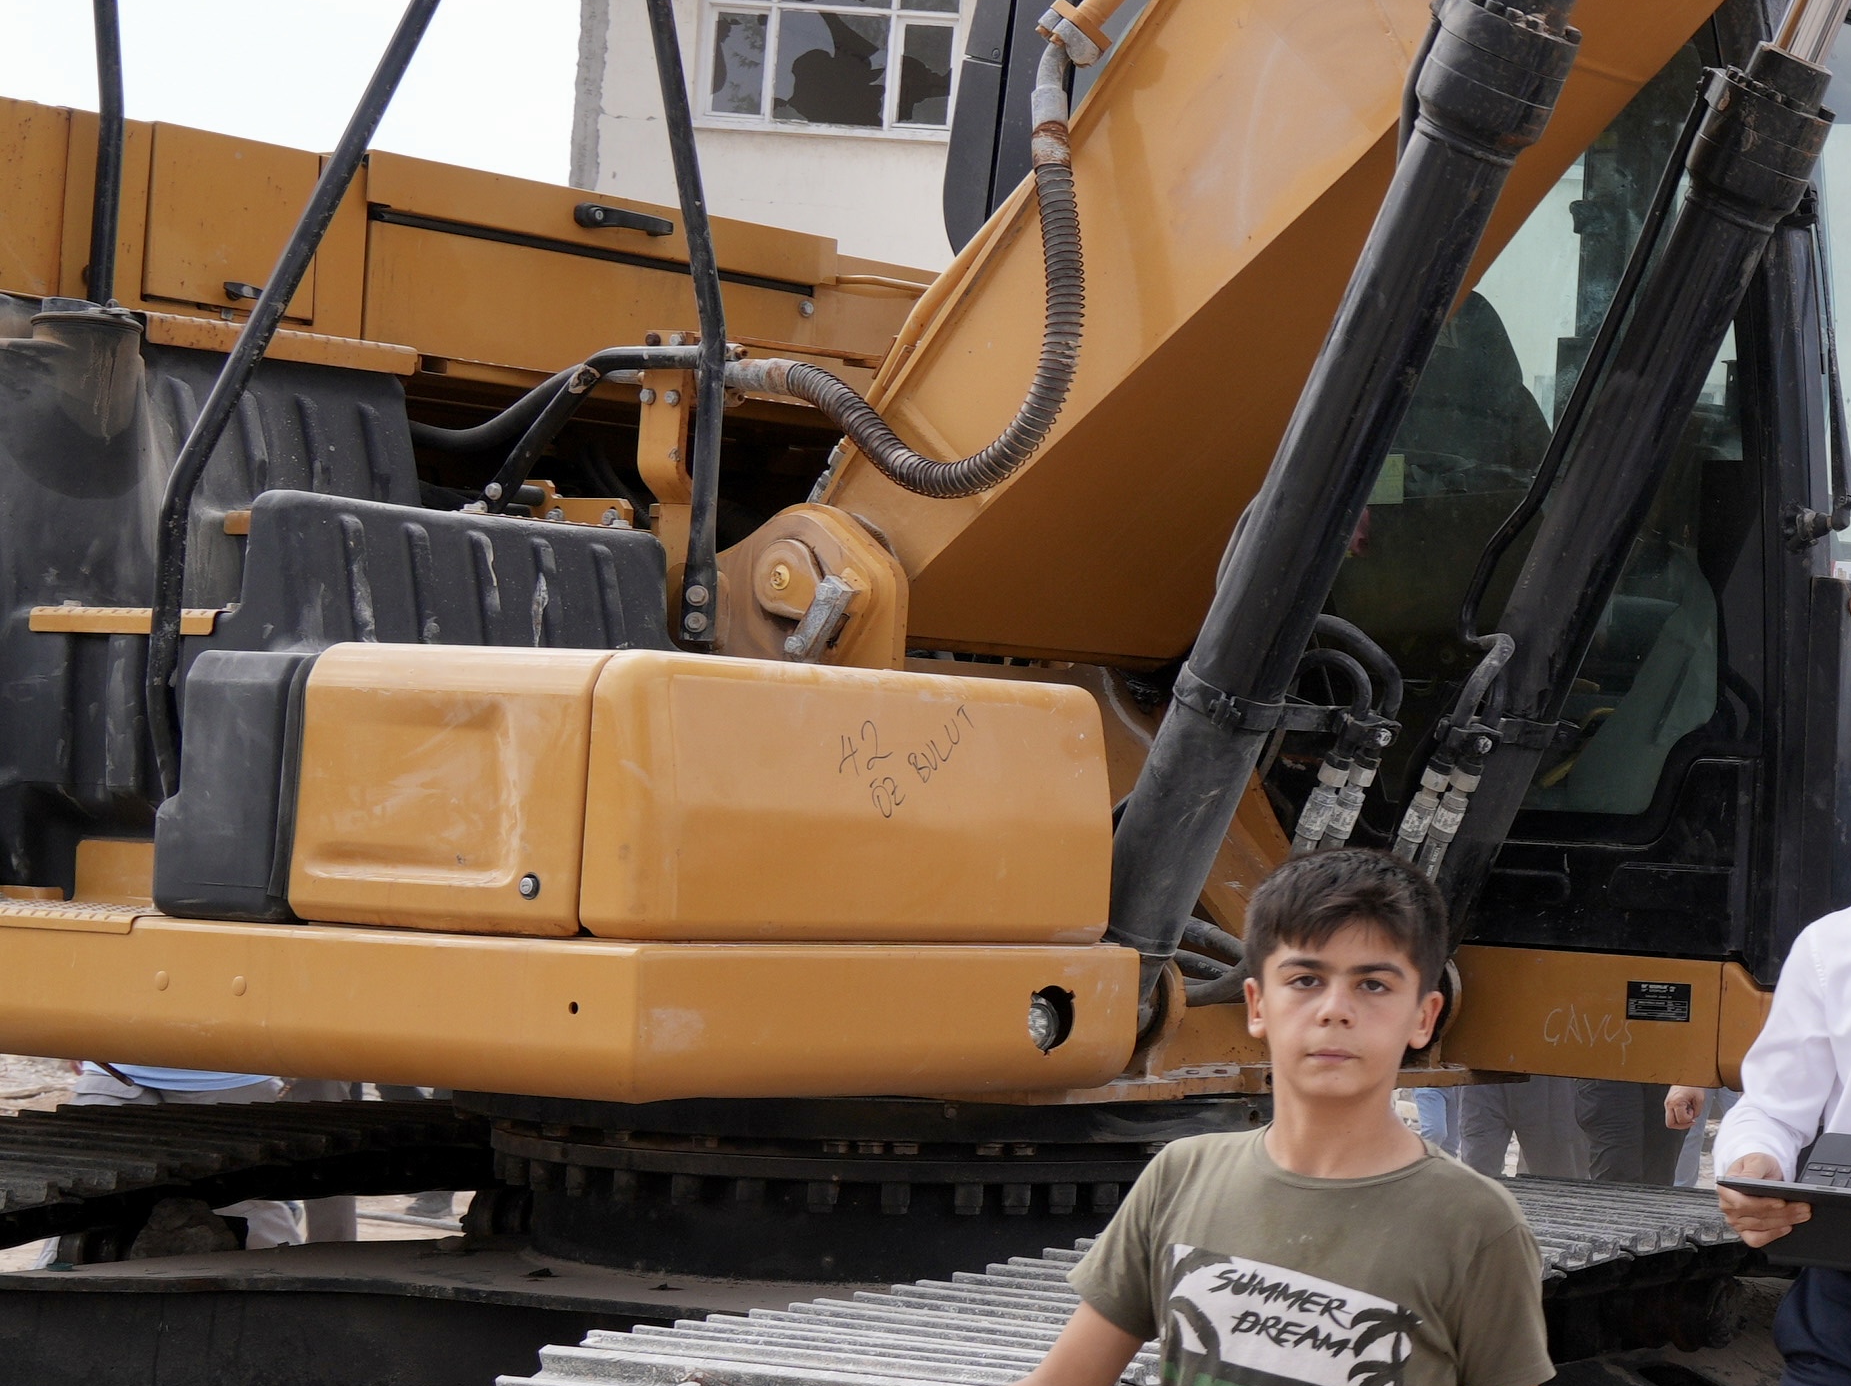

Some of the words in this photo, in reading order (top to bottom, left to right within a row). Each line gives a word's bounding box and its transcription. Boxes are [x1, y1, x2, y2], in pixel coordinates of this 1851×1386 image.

[839, 720, 893, 777] 42
[907, 704, 974, 783] BULUT
[1207, 1269, 1353, 1331] SUMMER
[1231, 1309, 1356, 1358] DREAM
